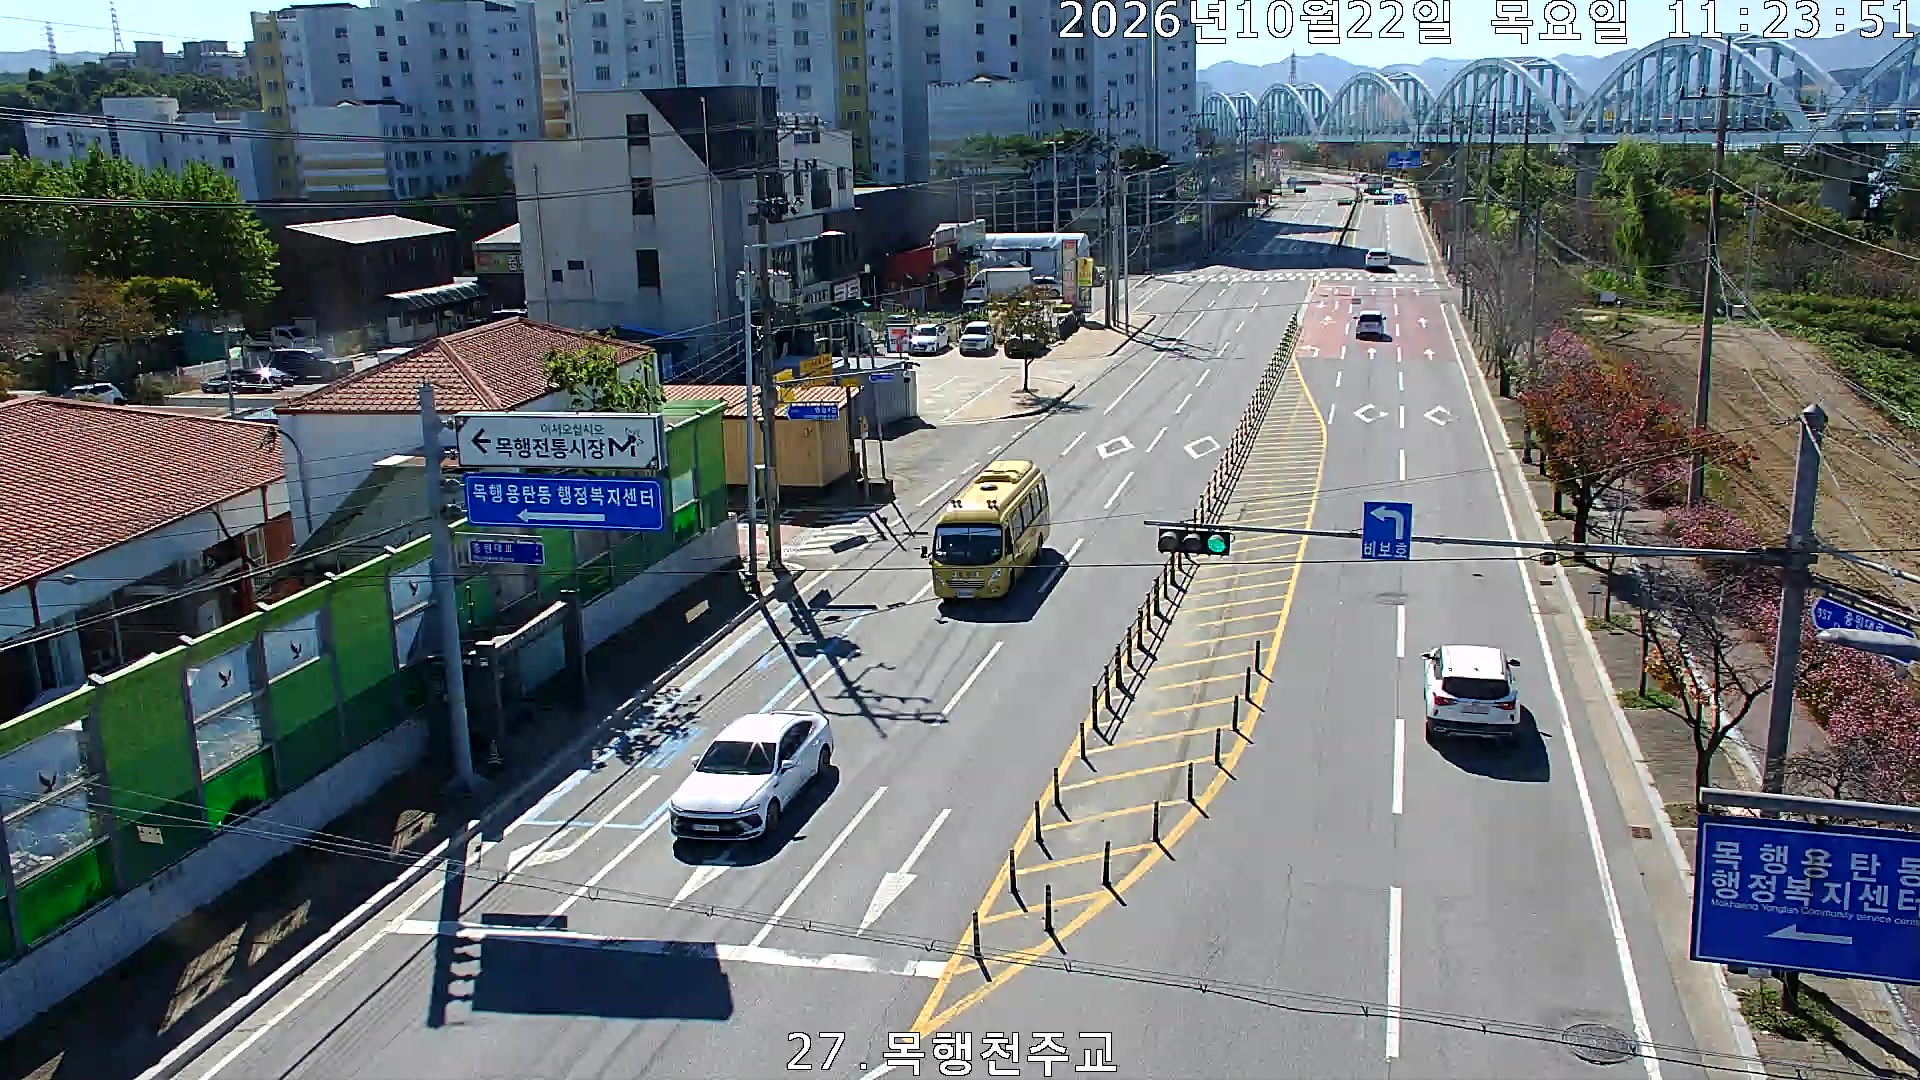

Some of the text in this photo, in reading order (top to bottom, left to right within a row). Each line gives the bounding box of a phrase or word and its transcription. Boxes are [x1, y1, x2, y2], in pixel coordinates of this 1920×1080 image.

[496, 437, 605, 460] 목행전통시장
[473, 483, 654, 508] 목행용탄동 행정복지센터
[1364, 540, 1407, 559] 비보호
[1711, 841, 1920, 888] 목행용탄동
[1710, 869, 1920, 914] 행정복지센터
